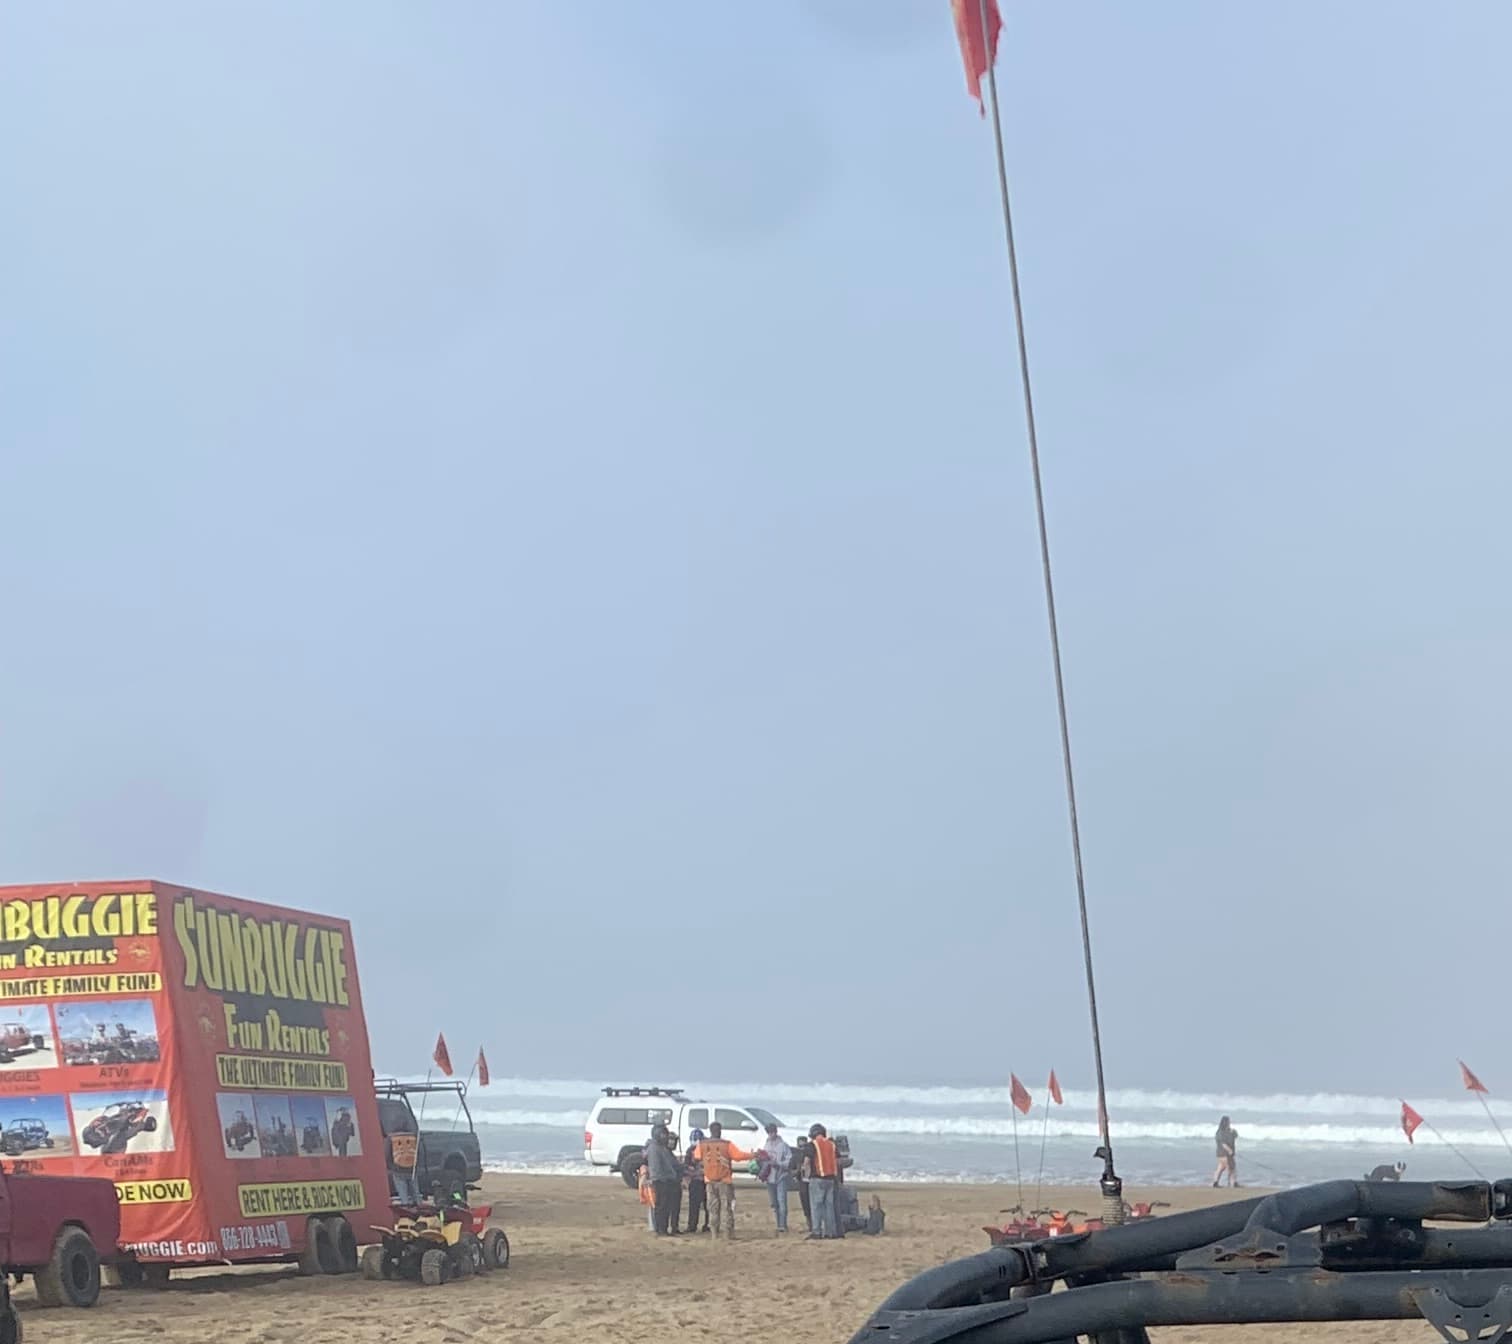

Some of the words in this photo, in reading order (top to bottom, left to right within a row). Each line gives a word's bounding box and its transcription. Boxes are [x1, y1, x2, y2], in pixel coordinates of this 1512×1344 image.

[0, 893, 158, 941] BUGGIE
[174, 896, 348, 1005] SUNBUGGIE
[1, 979, 49, 997] IMATE
[53, 975, 110, 994] FAMILY
[117, 974, 156, 991] FUN!
[218, 1057, 239, 1084] THE
[116, 1186, 135, 1201] DE
[139, 1183, 185, 1200] NOW
[242, 1189, 271, 1214] RENT
[272, 1187, 302, 1212] HERE
[303, 1187, 312, 1209] &
[312, 1185, 336, 1209] RIDE
[337, 1184, 361, 1206] NOW
